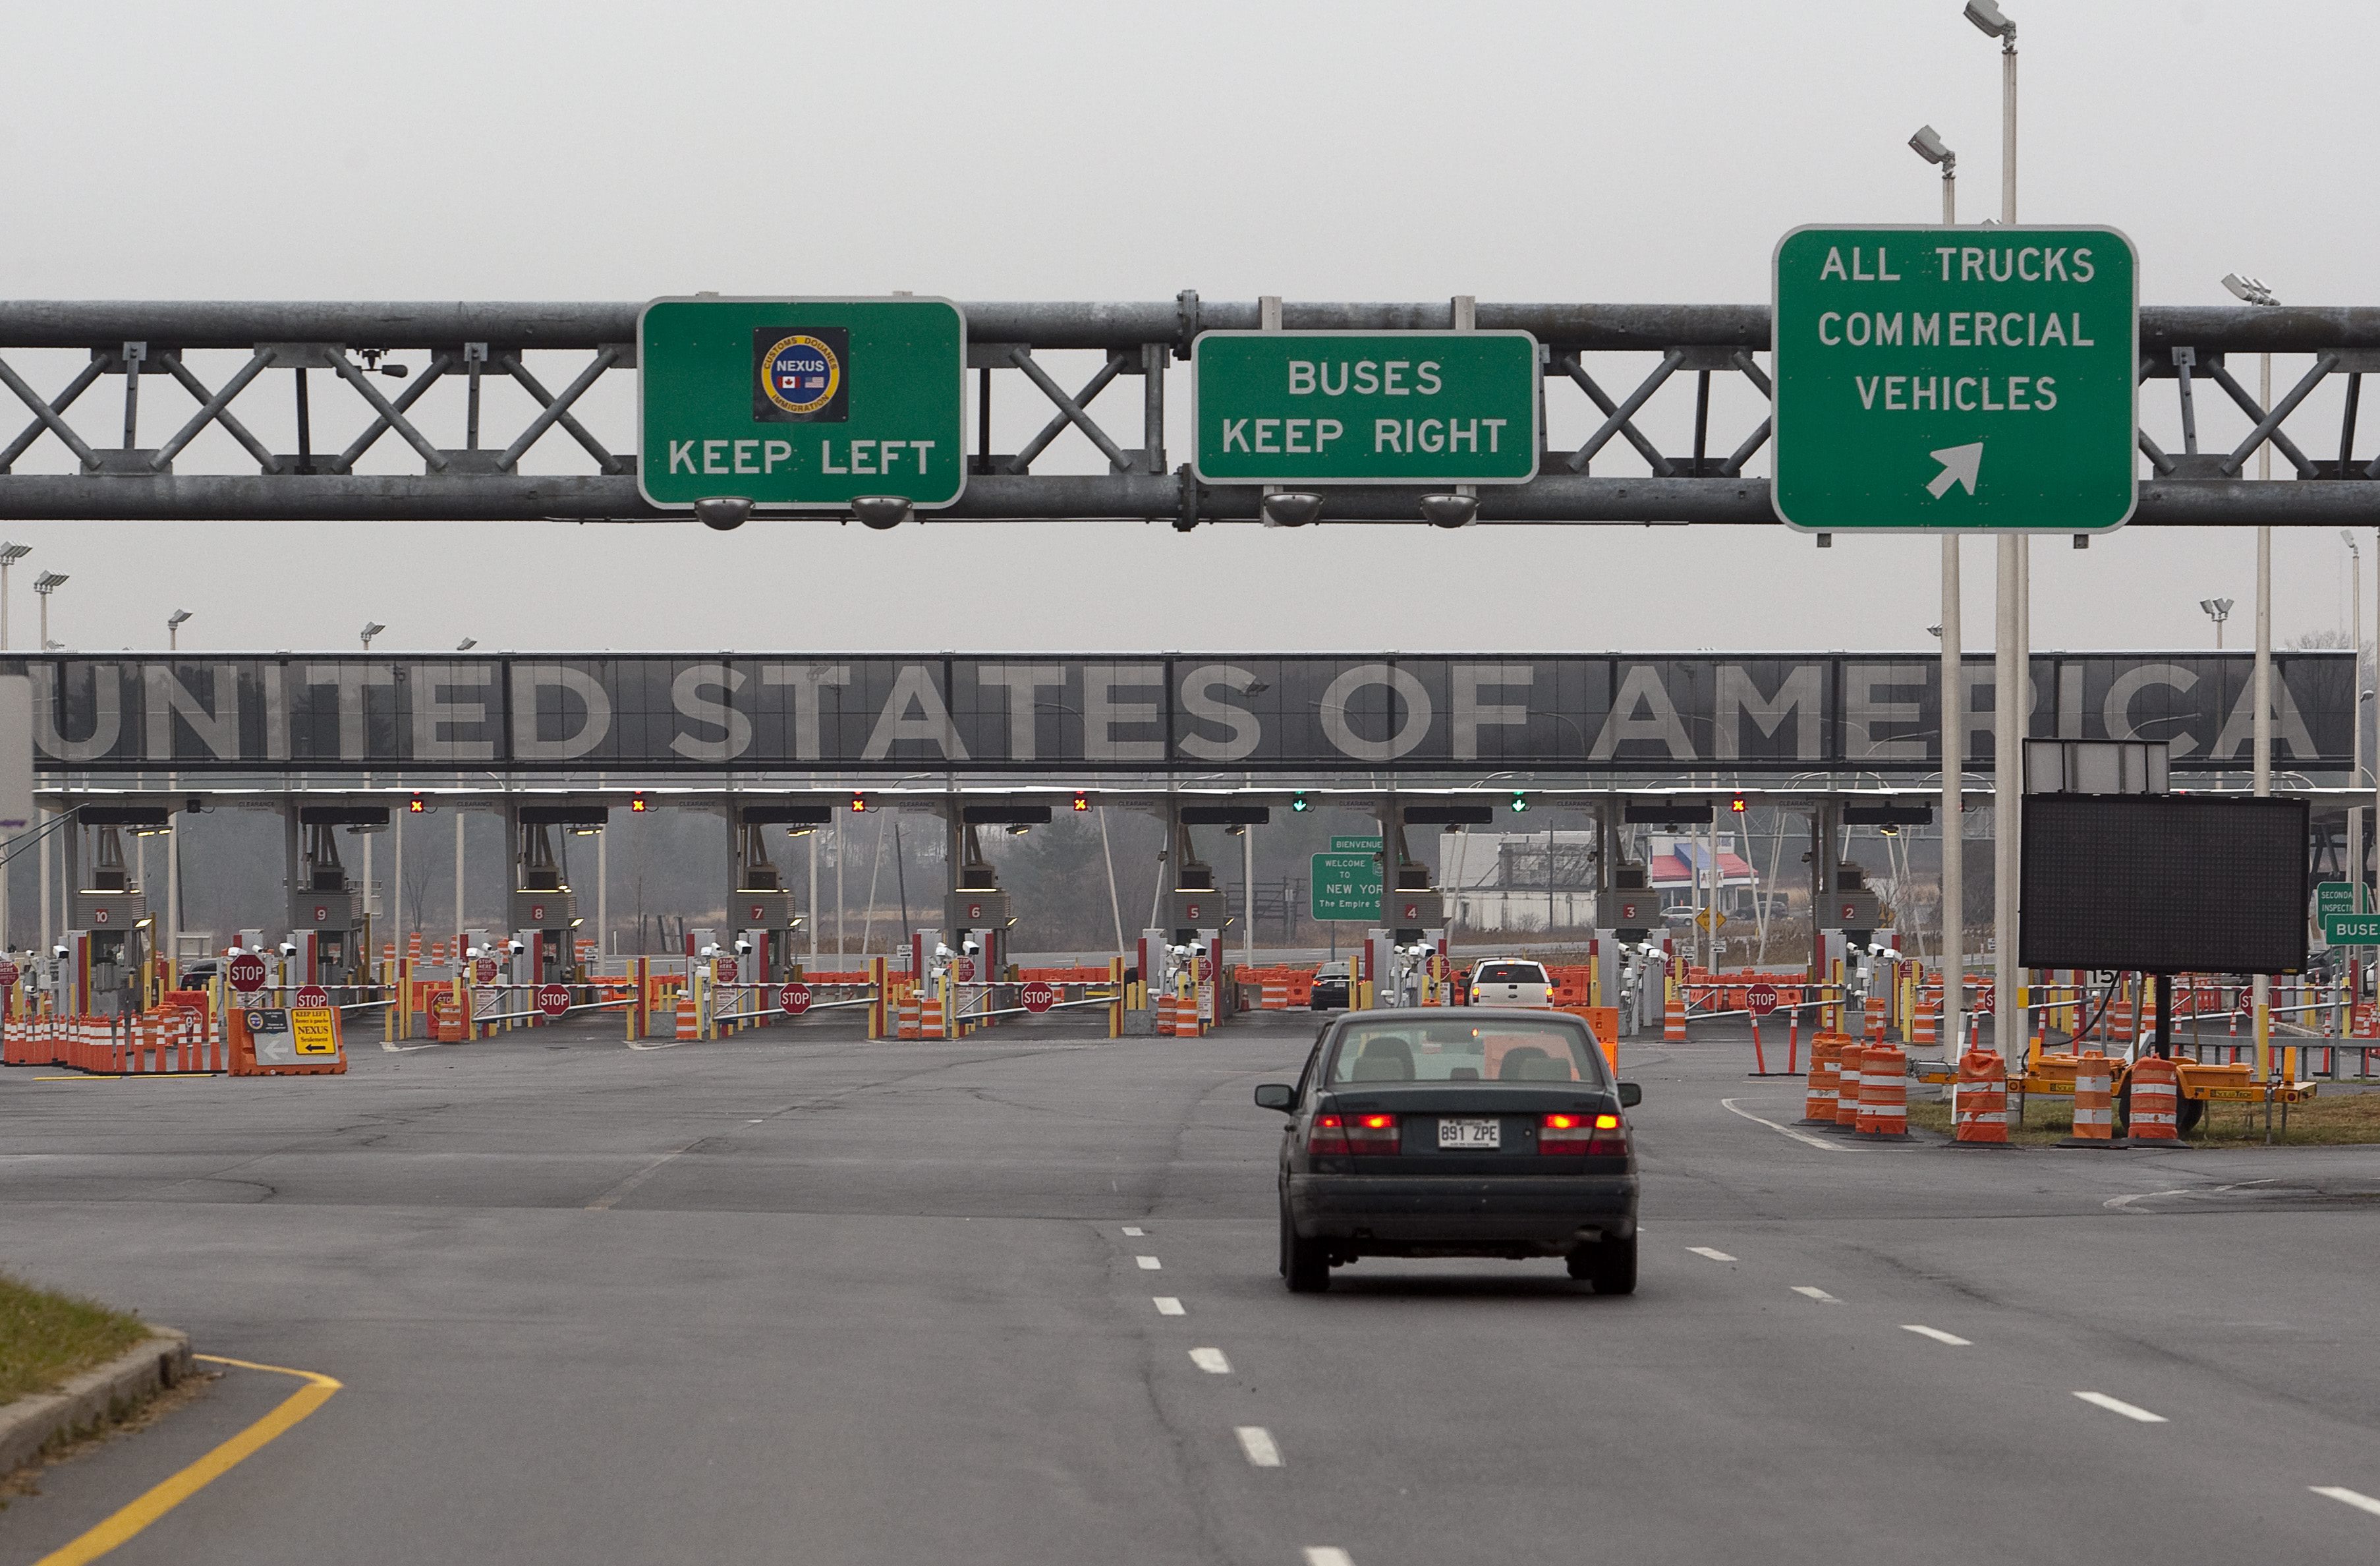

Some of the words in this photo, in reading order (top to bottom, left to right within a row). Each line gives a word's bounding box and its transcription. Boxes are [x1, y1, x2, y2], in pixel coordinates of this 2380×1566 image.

[1820, 246, 1900, 281] ALL
[1935, 246, 2095, 283] TRUCKS
[1819, 311, 2095, 347] COMMERCIAL
[764, 337, 798, 370] CUSTOMS
[804, 337, 837, 370] DOUANES
[776, 360, 825, 372] NEXUS
[1288, 361, 1442, 396] BUSES
[1855, 376, 2058, 411] VEHICLES
[772, 393, 830, 412] IMMIGRATION
[1222, 419, 1344, 453] KEEP
[1374, 419, 1507, 453] RIGHT
[669, 440, 792, 475] KEEP
[822, 440, 936, 475] LEFT
[28, 664, 613, 762] UNITED
[668, 663, 1262, 763] STATES
[1319, 664, 1534, 762] OF
[1326, 884, 1353, 894] NEW
[1359, 884, 1383, 894] YOR
[1339, 900, 1370, 909] Empire
[95, 912, 108, 923] 10
[317, 910, 326, 920] 9
[535, 908, 543, 919] 8
[754, 908, 763, 919] 7
[971, 907, 980, 917] 6
[1191, 908, 1199, 918] 5
[1407, 908, 1417, 919] 4
[1627, 907, 1635, 917] 3
[1845, 908, 1854, 919] 2
[2336, 923, 2380, 936] BUSE
[231, 966, 264, 981] STOP
[2092, 970, 2114, 983] 15
[298, 995, 326, 1007] STOP
[540, 994, 569, 1006] STOP
[781, 992, 809, 1004] STOP
[1024, 991, 1052, 1004] STOP
[1748, 993, 1776, 1006] STOP
[2242, 996, 2254, 1008] ST
[297, 1026, 329, 1034] NEXUS
[1441, 1126, 1464, 1141] 891
[1473, 1126, 1498, 1141] ZPE
